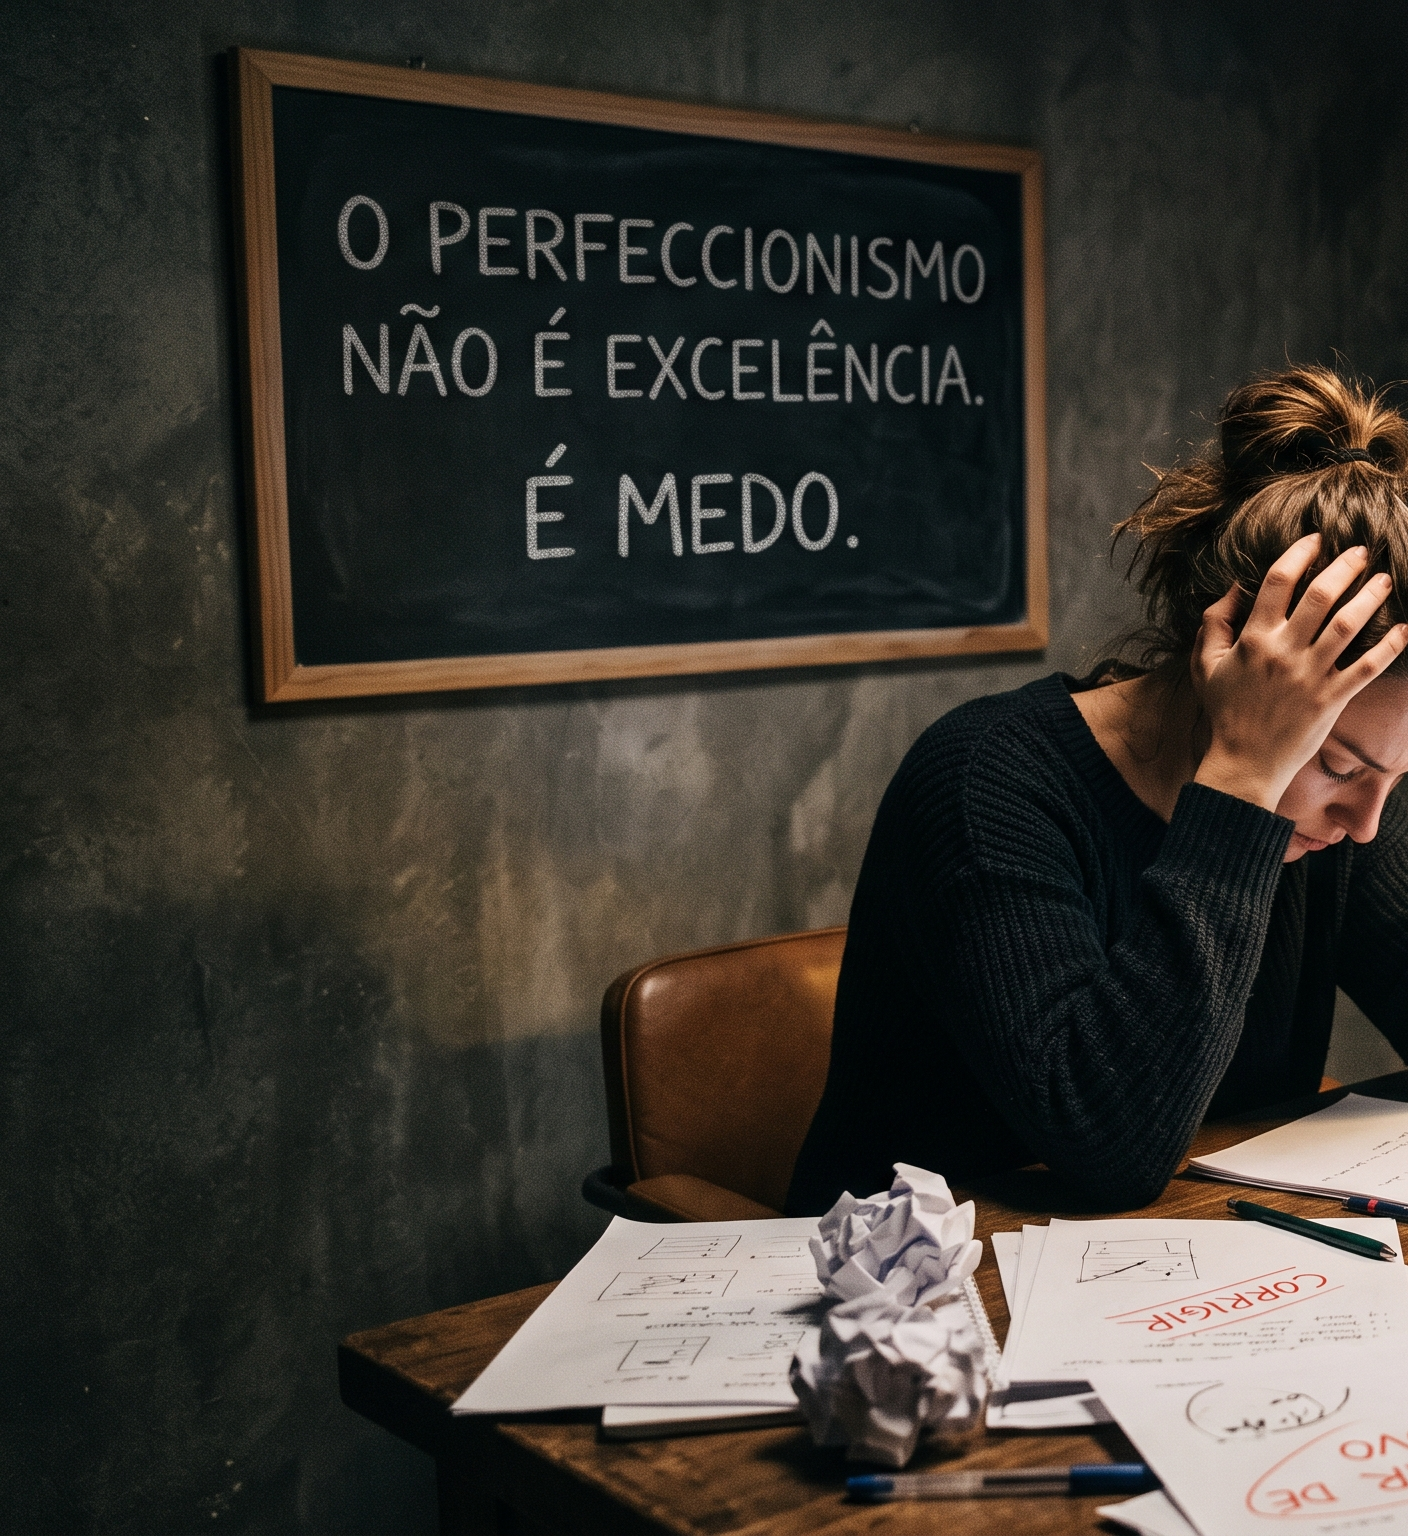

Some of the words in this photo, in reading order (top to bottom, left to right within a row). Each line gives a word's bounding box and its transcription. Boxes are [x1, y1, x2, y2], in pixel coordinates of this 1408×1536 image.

[338, 195, 390, 270] O
[430, 202, 985, 303] PERFECCIONISMO
[343, 303, 497, 397] NÃO
[534, 307, 573, 397] É
[607, 318, 985, 405] EXCELÊNCIA.
[526, 443, 576, 560] É
[618, 471, 859, 558] MEDO.
[1116, 1273, 1328, 1332] CORRIGIR
[1266, 1482, 1338, 1514] DE
